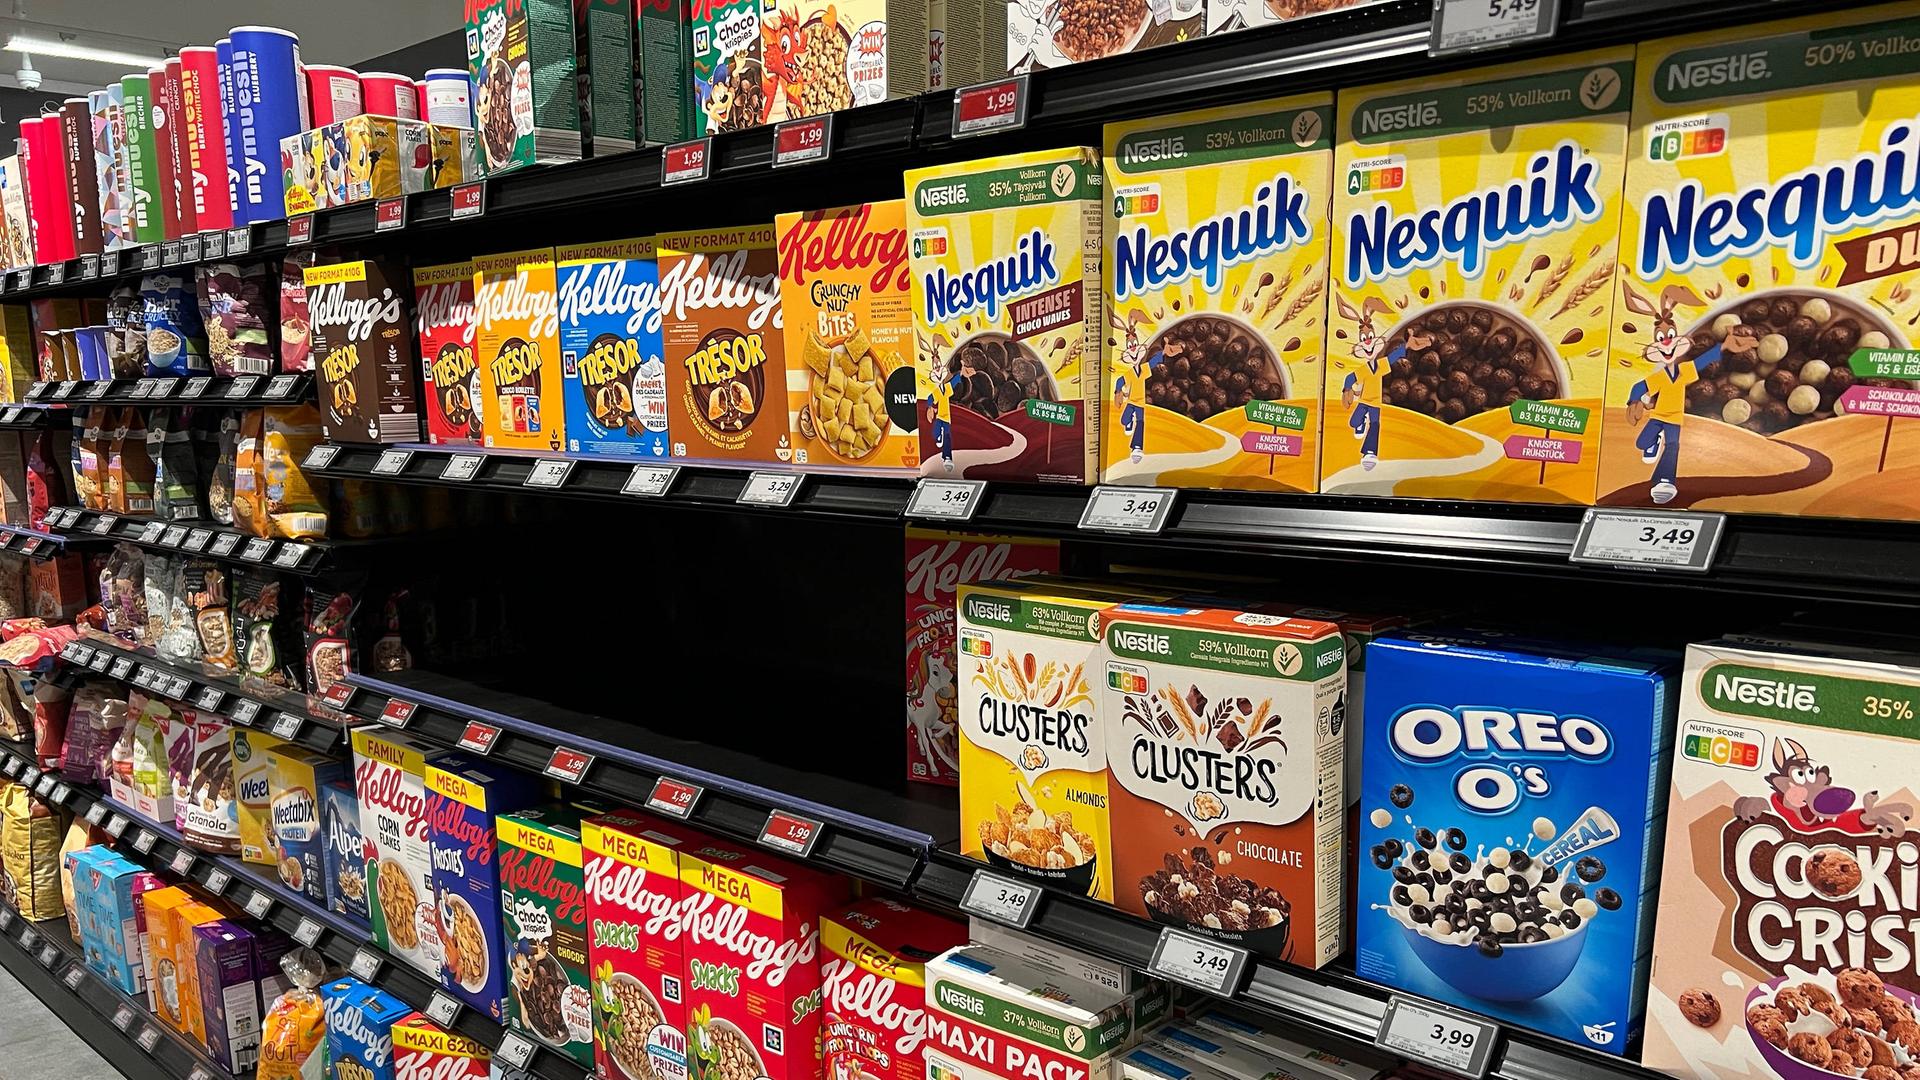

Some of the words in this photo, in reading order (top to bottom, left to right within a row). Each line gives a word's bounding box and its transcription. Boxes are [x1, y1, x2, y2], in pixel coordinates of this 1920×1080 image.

[719, 15, 755, 42] choco
[724, 28, 753, 50] krispies
[861, 33, 882, 50] WIN
[1804, 41, 1856, 67] 50%
[1861, 36, 1920, 58] Vollko
[248, 51, 261, 103] BLUEBERRY
[853, 67, 884, 83] PRIZES
[224, 64, 236, 113] BLUEBERRY
[986, 92, 1015, 112] 1,99
[1466, 93, 1504, 115] 53%
[1508, 86, 1572, 109] Vollkorn
[138, 95, 146, 129] BIRCHER
[232, 51, 266, 204] mymuesli
[1655, 118, 1710, 131] NUTRI-SCORE
[181, 70, 208, 213] mymuesli
[800, 128, 823, 145] 1,99
[1205, 133, 1235, 150] 53%
[1237, 126, 1286, 145] Vollkorn
[126, 96, 151, 228] mymuesli
[684, 150, 703, 165] 1,99
[1351, 159, 1392, 169] NUTRI-SCORE
[1020, 169, 1046, 181] Vollkorn
[989, 180, 1012, 197] 35%
[1020, 191, 1046, 203] Fullkorn
[1642, 125, 1920, 276] Nesqui
[1350, 145, 1592, 282] Nesquik
[1116, 177, 1307, 296] Nesquik
[561, 251, 582, 261] NEW
[584, 246, 624, 259] FORMAT
[626, 242, 652, 255] 410G
[1865, 230, 1920, 273] DU
[926, 231, 1056, 323] Nesquik
[560, 257, 662, 334] Kellogg
[810, 279, 862, 301] CRUNCHY
[308, 282, 400, 341] Kellogg's
[418, 282, 476, 343] Kellog
[475, 271, 559, 339] Kellogg
[827, 299, 847, 313] NUT
[1016, 291, 1071, 323] INTENSE
[871, 327, 893, 335] HONEY
[1016, 317, 1042, 336] CHOCO
[1042, 309, 1072, 328] WAVES
[871, 335, 899, 344] FLAVOUR
[322, 344, 360, 383] TRÉSOR
[491, 342, 543, 387] TRÉSOR
[578, 339, 642, 386] TRÉSOR
[685, 334, 767, 386] TRÉSOR
[648, 400, 664, 414] WIN
[894, 394, 917, 404] NEW
[1035, 401, 1057, 414] VITAMIN
[1058, 405, 1068, 415] B6,
[1258, 402, 1286, 415] VITAMIN
[1286, 406, 1298, 418] B6,
[1253, 409, 1264, 419] B3,
[1265, 411, 1275, 421] B5
[1275, 413, 1282, 422] &
[1283, 414, 1302, 426] EISEN
[1519, 411, 1533, 422] B3,
[1534, 413, 1547, 423] B5
[1548, 415, 1556, 424] &
[1557, 417, 1581, 429] EISEN
[1527, 403, 1560, 415] VITAMIN
[1562, 408, 1576, 420] B6,
[647, 420, 666, 428] PRIZES
[1522, 447, 1565, 460] FRÜHSTÜCK
[1528, 439, 1563, 450] KNUSPER
[548, 466, 565, 476] 3,29
[649, 473, 668, 483] 3,29
[768, 481, 790, 492] 3,29
[942, 490, 970, 503] 3,49
[1123, 500, 1157, 514] 3,49
[1639, 527, 1695, 546] 3,49
[1032, 607, 1050, 619] 63%
[1050, 609, 1085, 624] Vollkorn
[1199, 639, 1222, 652] 59%
[1222, 643, 1269, 660] Vollkorn
[1862, 696, 1914, 720] 35%
[979, 695, 1089, 755] CLUSTERS
[1393, 708, 1608, 759] OREO
[1690, 724, 1745, 739] NUTRI-SCORE
[477, 731, 493, 742] 1,99
[368, 740, 405, 765] FAMILY
[566, 758, 585, 770] 1,99
[1132, 738, 1278, 803] CLUSTERS
[436, 773, 467, 799] MEGA
[671, 790, 692, 804] 1,99
[1065, 788, 1106, 808] ALMONDS
[188, 810, 228, 832] Granola
[273, 797, 316, 825] Weetabix
[281, 828, 307, 840] PROTEIN
[378, 815, 400, 837] CORN
[787, 825, 810, 840] 1,99
[379, 832, 401, 851] FLAKES
[518, 828, 555, 854] MEGA
[603, 833, 649, 865] MEGA
[1542, 818, 1614, 867] CEREAL
[1237, 840, 1303, 868] CHOCOLATE
[1735, 824, 1920, 912] COOKi
[500, 851, 585, 924] Kellogg
[702, 866, 752, 903] MEGA
[584, 857, 682, 940] Kellogg
[997, 889, 1025, 906] 3,49
[518, 909, 548, 925] choco
[524, 923, 547, 934] krispies
[1747, 901, 1920, 976] CRiS
[682, 892, 819, 988] Kellogg's
[557, 946, 585, 965] CHOCOS
[845, 937, 896, 975] MEGA
[1193, 950, 1228, 971] 3,49
[821, 959, 926, 1054] Kellog
[324, 997, 392, 1067] Kellogg
[1003, 1009, 1026, 1027] 37%
[1027, 1016, 1060, 1035] Vollkorn
[405, 1031, 444, 1050] MAXI
[447, 1038, 489, 1056] 620G
[660, 1029, 684, 1053] WIN
[1430, 1023, 1475, 1048] 3,99
[1590, 1031, 1607, 1042] x11
[514, 1044, 529, 1057] 4,99
[649, 1045, 684, 1062] CUSTOMISABLE
[928, 1014, 995, 1064] MAXI
[1006, 1045, 1086, 1080] PACK
[653, 1056, 685, 1077] PRIZES
